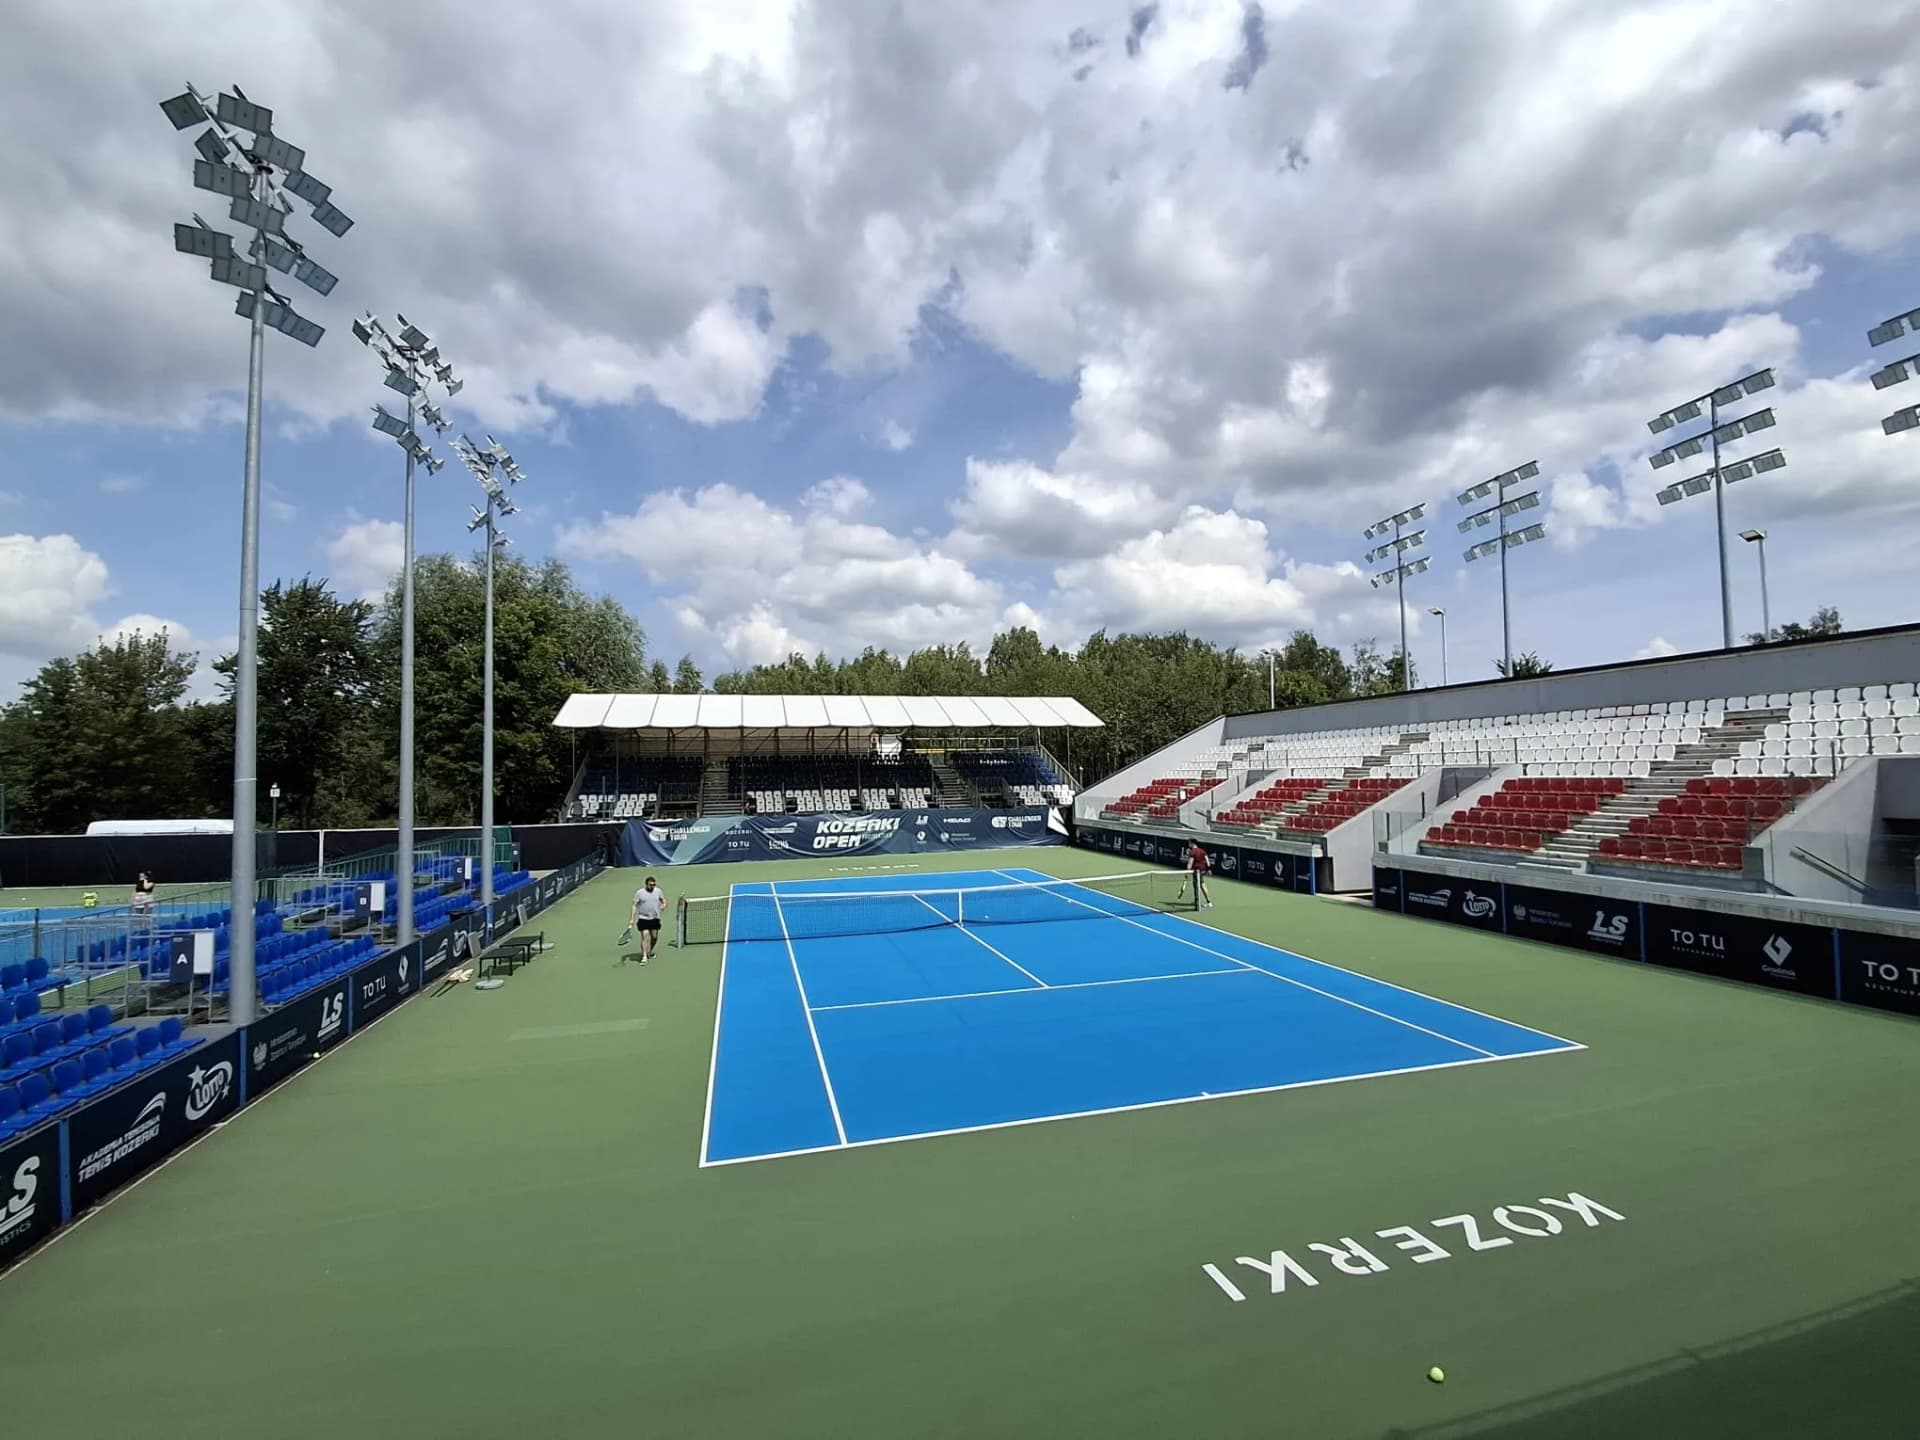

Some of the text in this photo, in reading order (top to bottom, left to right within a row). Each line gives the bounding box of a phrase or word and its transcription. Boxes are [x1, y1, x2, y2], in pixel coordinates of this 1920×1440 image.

[816, 818, 901, 834] KOZERKI
[813, 834, 862, 849] OPEN
[1592, 910, 1629, 936] LS
[1670, 929, 1725, 951] TO TU
[176, 953, 188, 965] A
[1861, 960, 1899, 981] TO
[362, 982, 375, 1000] TO
[375, 975, 387, 993] TU
[321, 992, 344, 1029] LS
[194, 1070, 225, 1109] LOTTO
[78, 1123, 160, 1183] TENIS KOZERKI
[1201, 1192, 1627, 1302] KOZERKI
